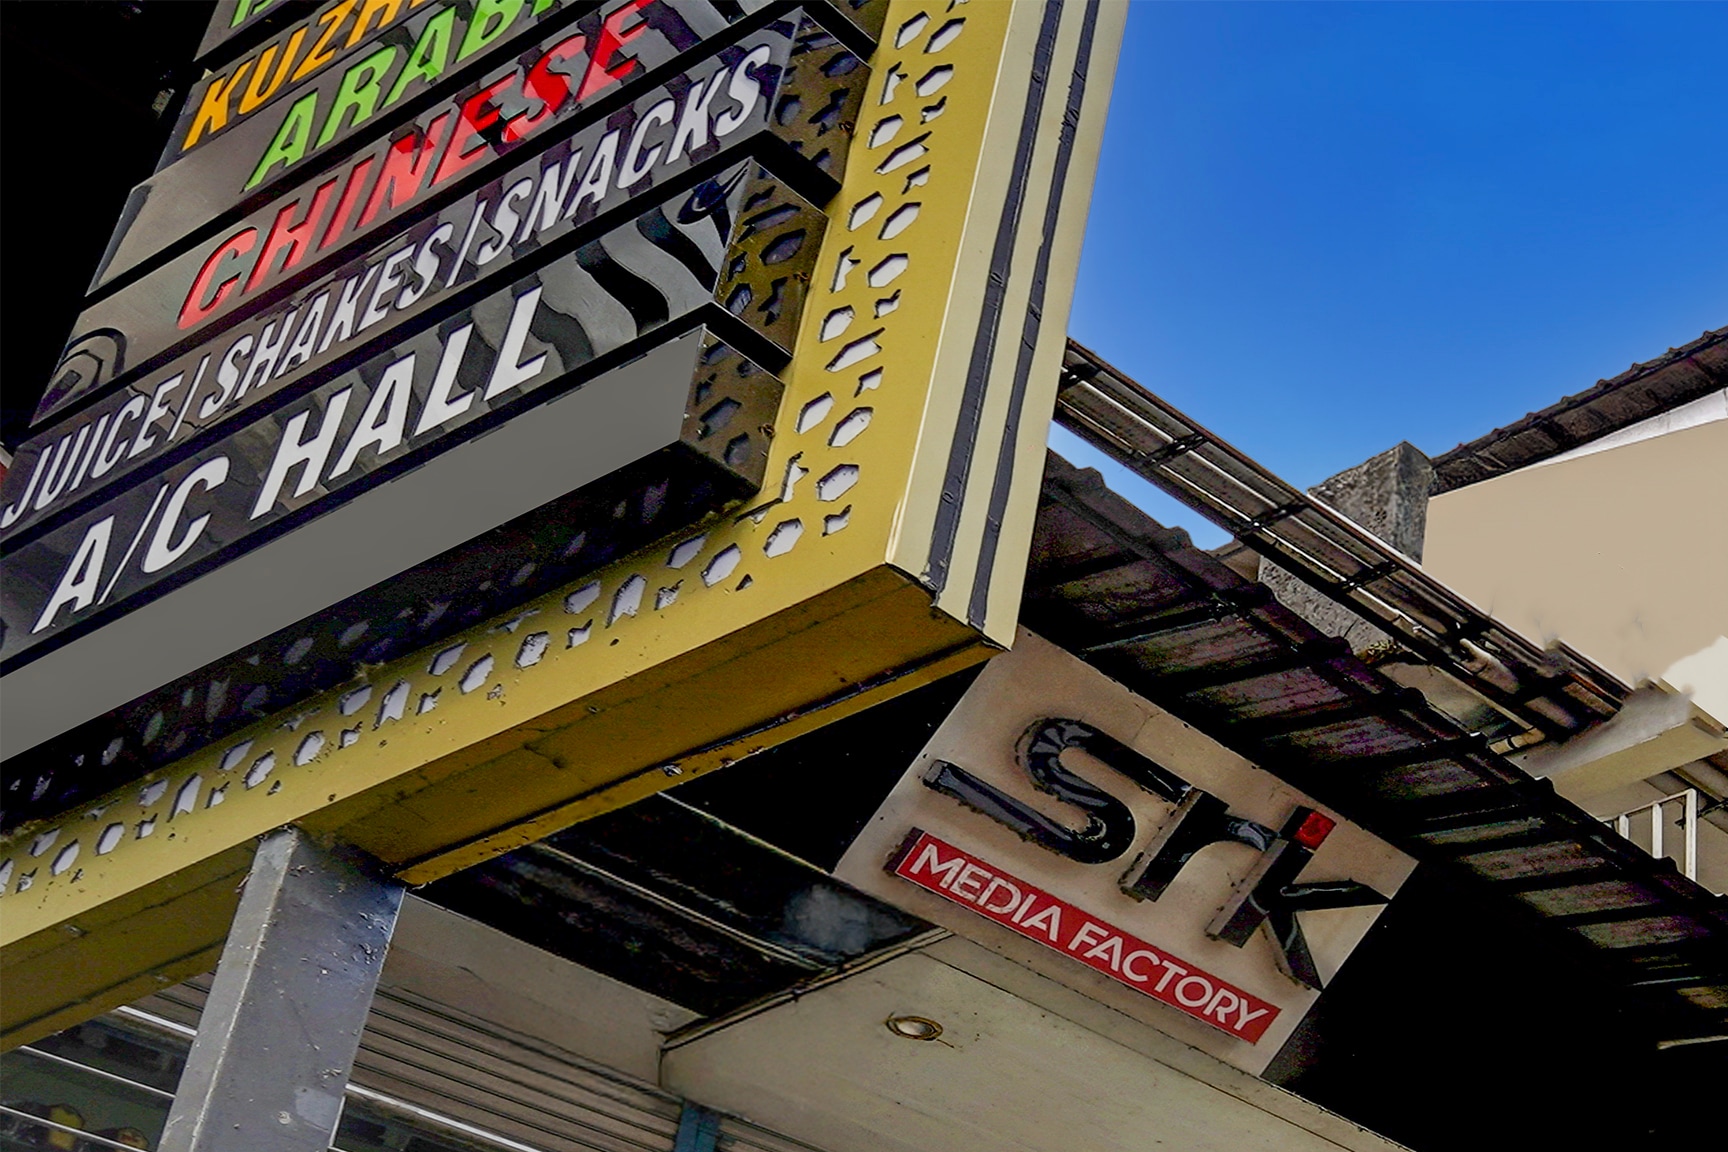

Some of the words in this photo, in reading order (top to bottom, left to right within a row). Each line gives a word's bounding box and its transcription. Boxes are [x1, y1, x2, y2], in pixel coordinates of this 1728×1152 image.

[177, 0, 658, 330] CHINESE
[245, 0, 553, 192] ARAB
[30, 455, 231, 635] A/C
[250, 287, 548, 521] HALL
[909, 843, 1061, 943] MEDIA
[1067, 920, 1271, 1033] FACTORY
